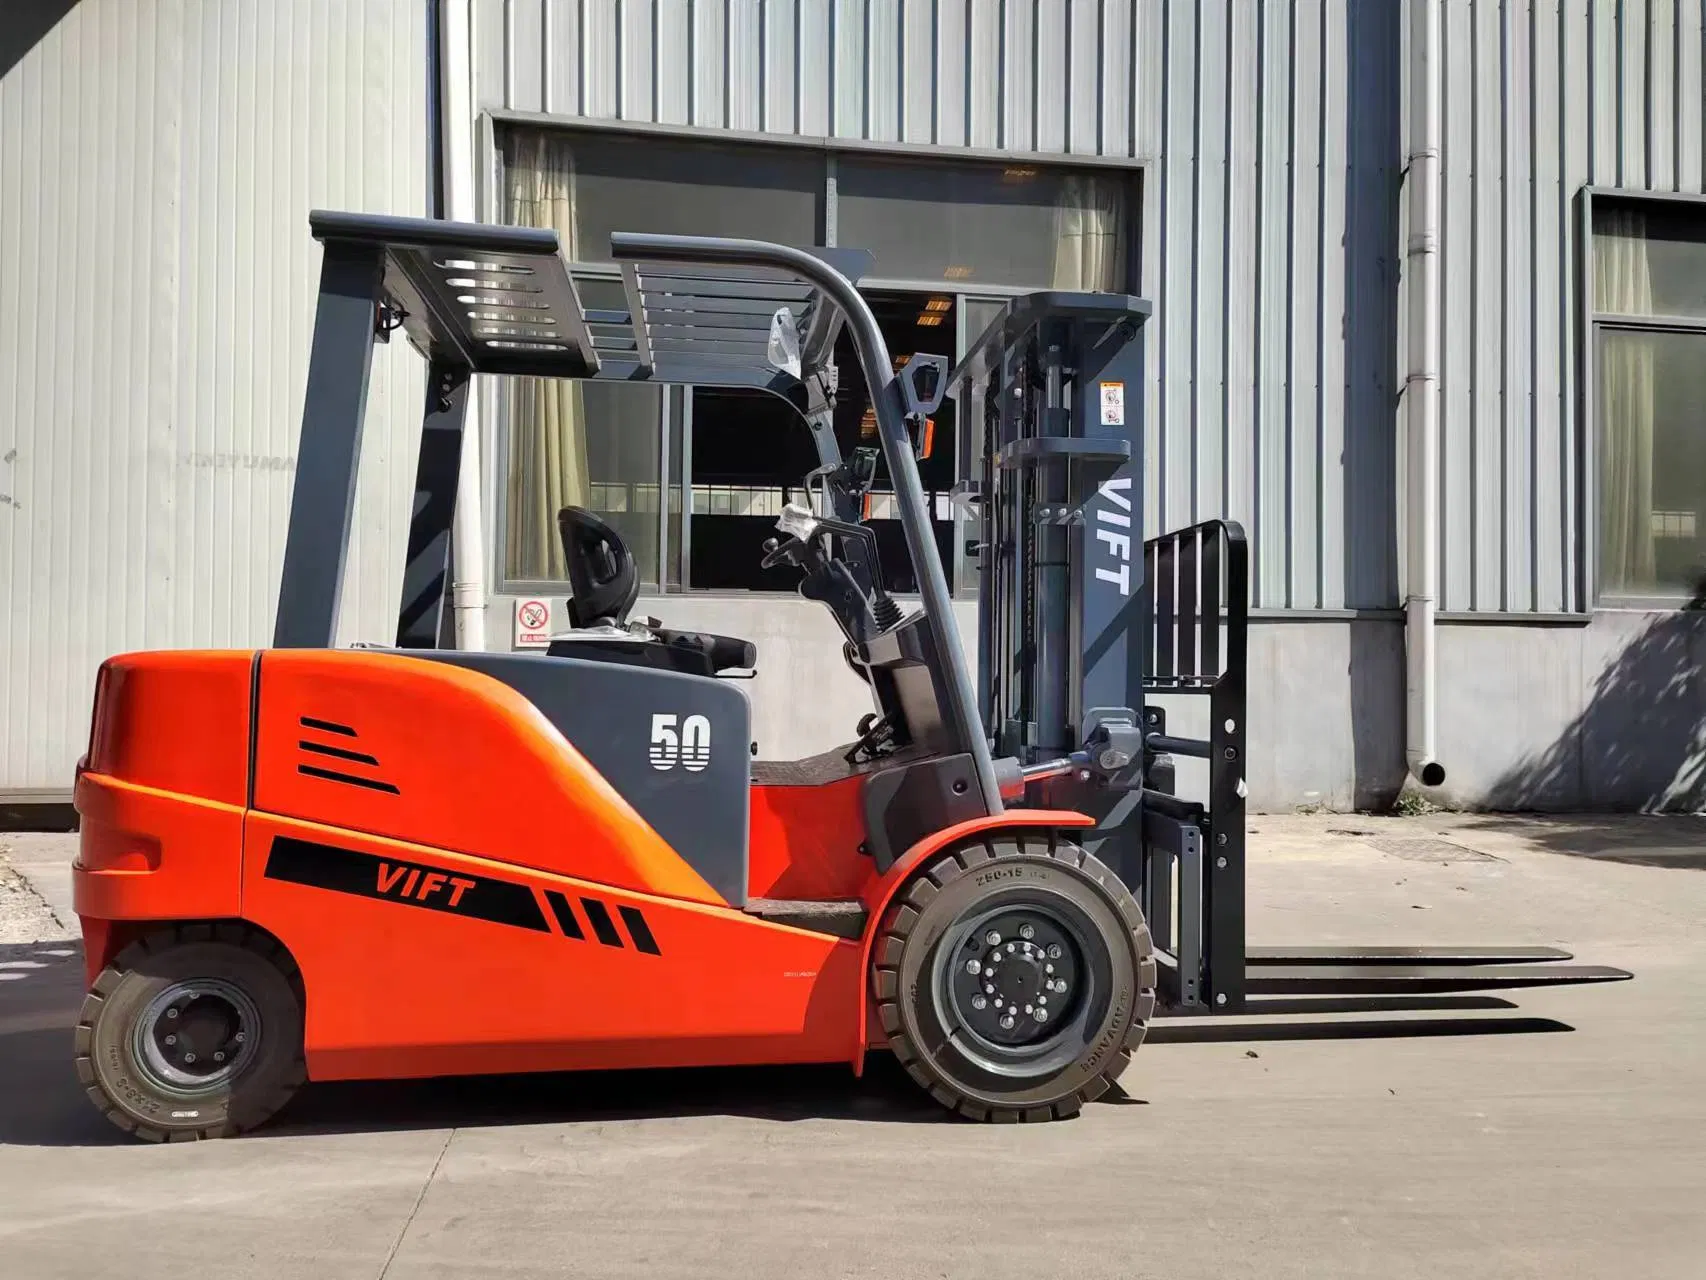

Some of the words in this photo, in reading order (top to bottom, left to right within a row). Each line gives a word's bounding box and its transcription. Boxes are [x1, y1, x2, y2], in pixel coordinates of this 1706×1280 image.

[1096, 478, 1132, 596] VIFT
[649, 714, 711, 772] 50
[377, 863, 476, 907] VIFT
